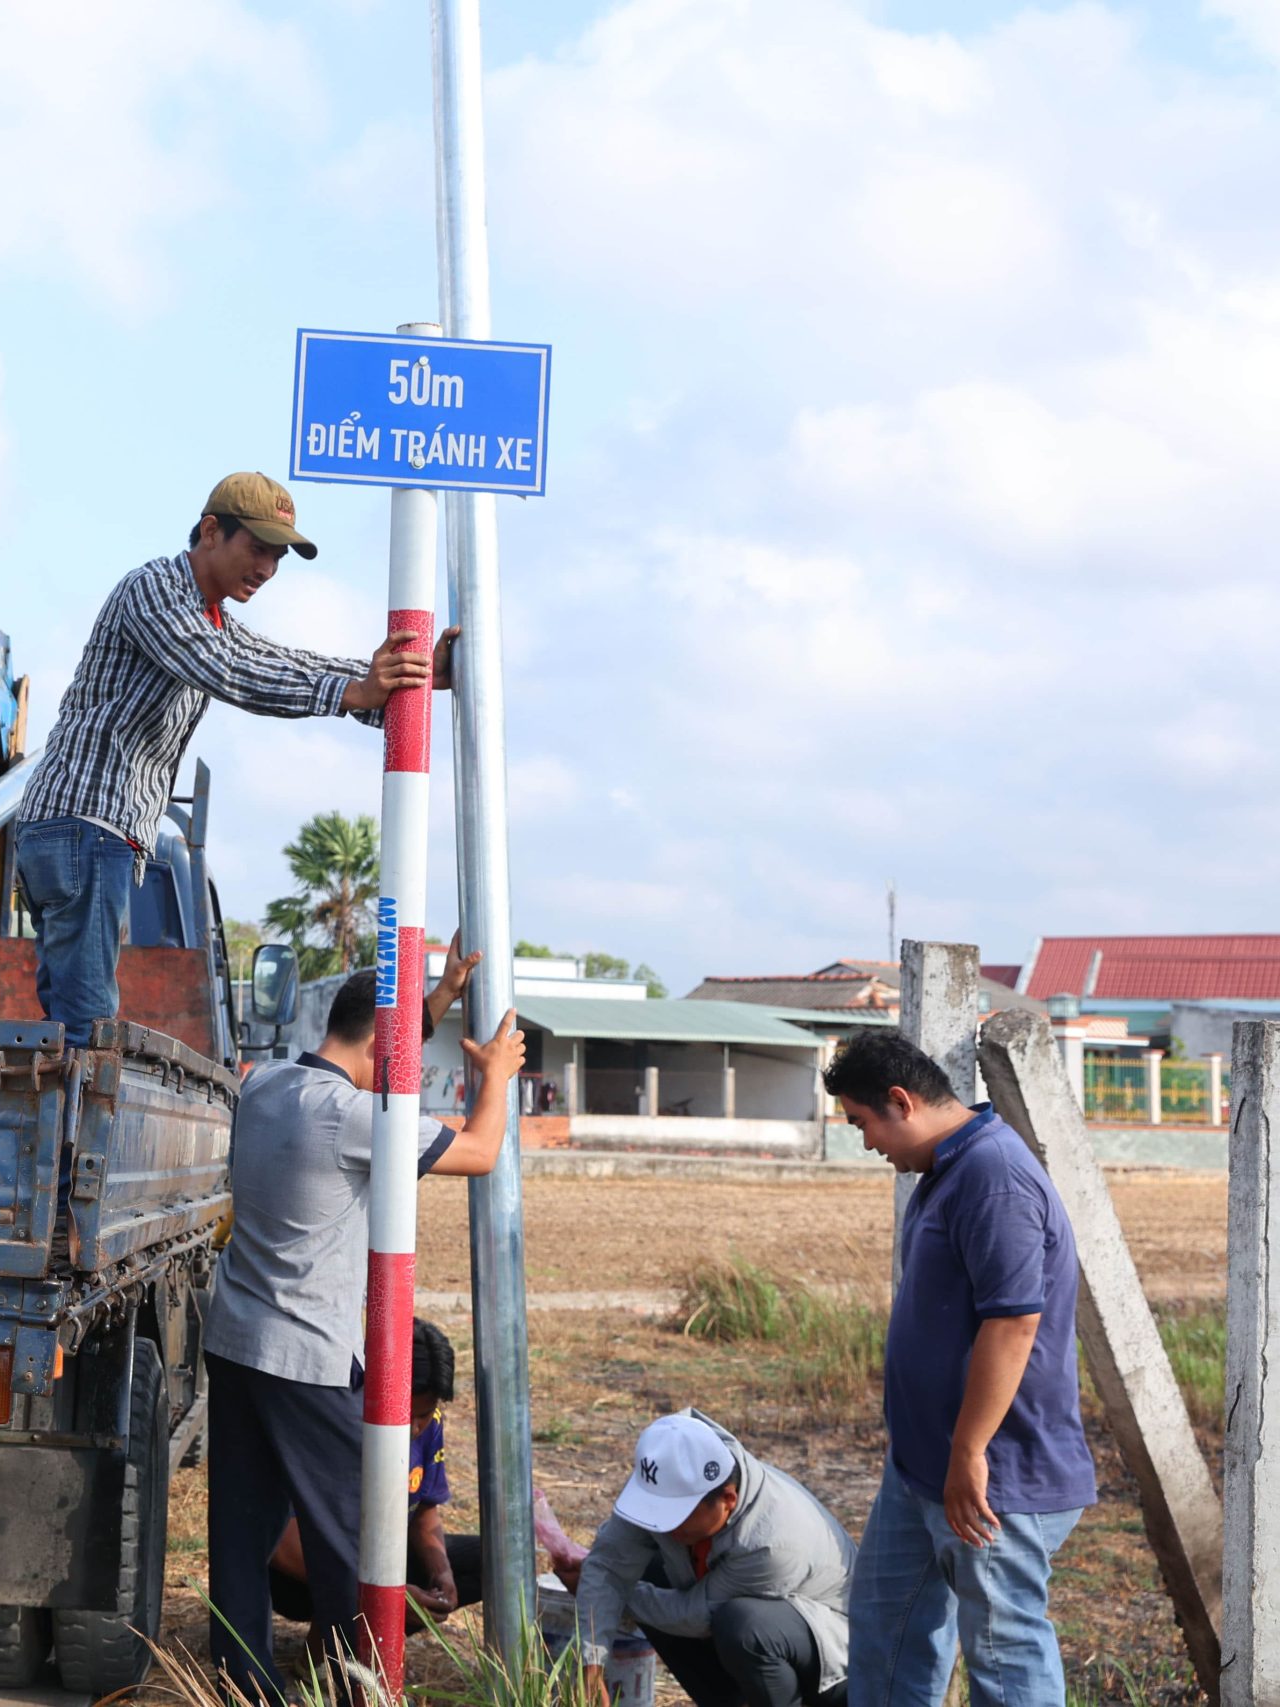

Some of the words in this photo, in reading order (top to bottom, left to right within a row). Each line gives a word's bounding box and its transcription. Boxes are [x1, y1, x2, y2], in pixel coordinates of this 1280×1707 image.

[388, 358, 464, 408] 50m
[307, 411, 380, 460] ĐIỂM
[390, 423, 486, 468] TRÁNH
[495, 436, 532, 471] XE
[640, 1456, 658, 1486] NY
